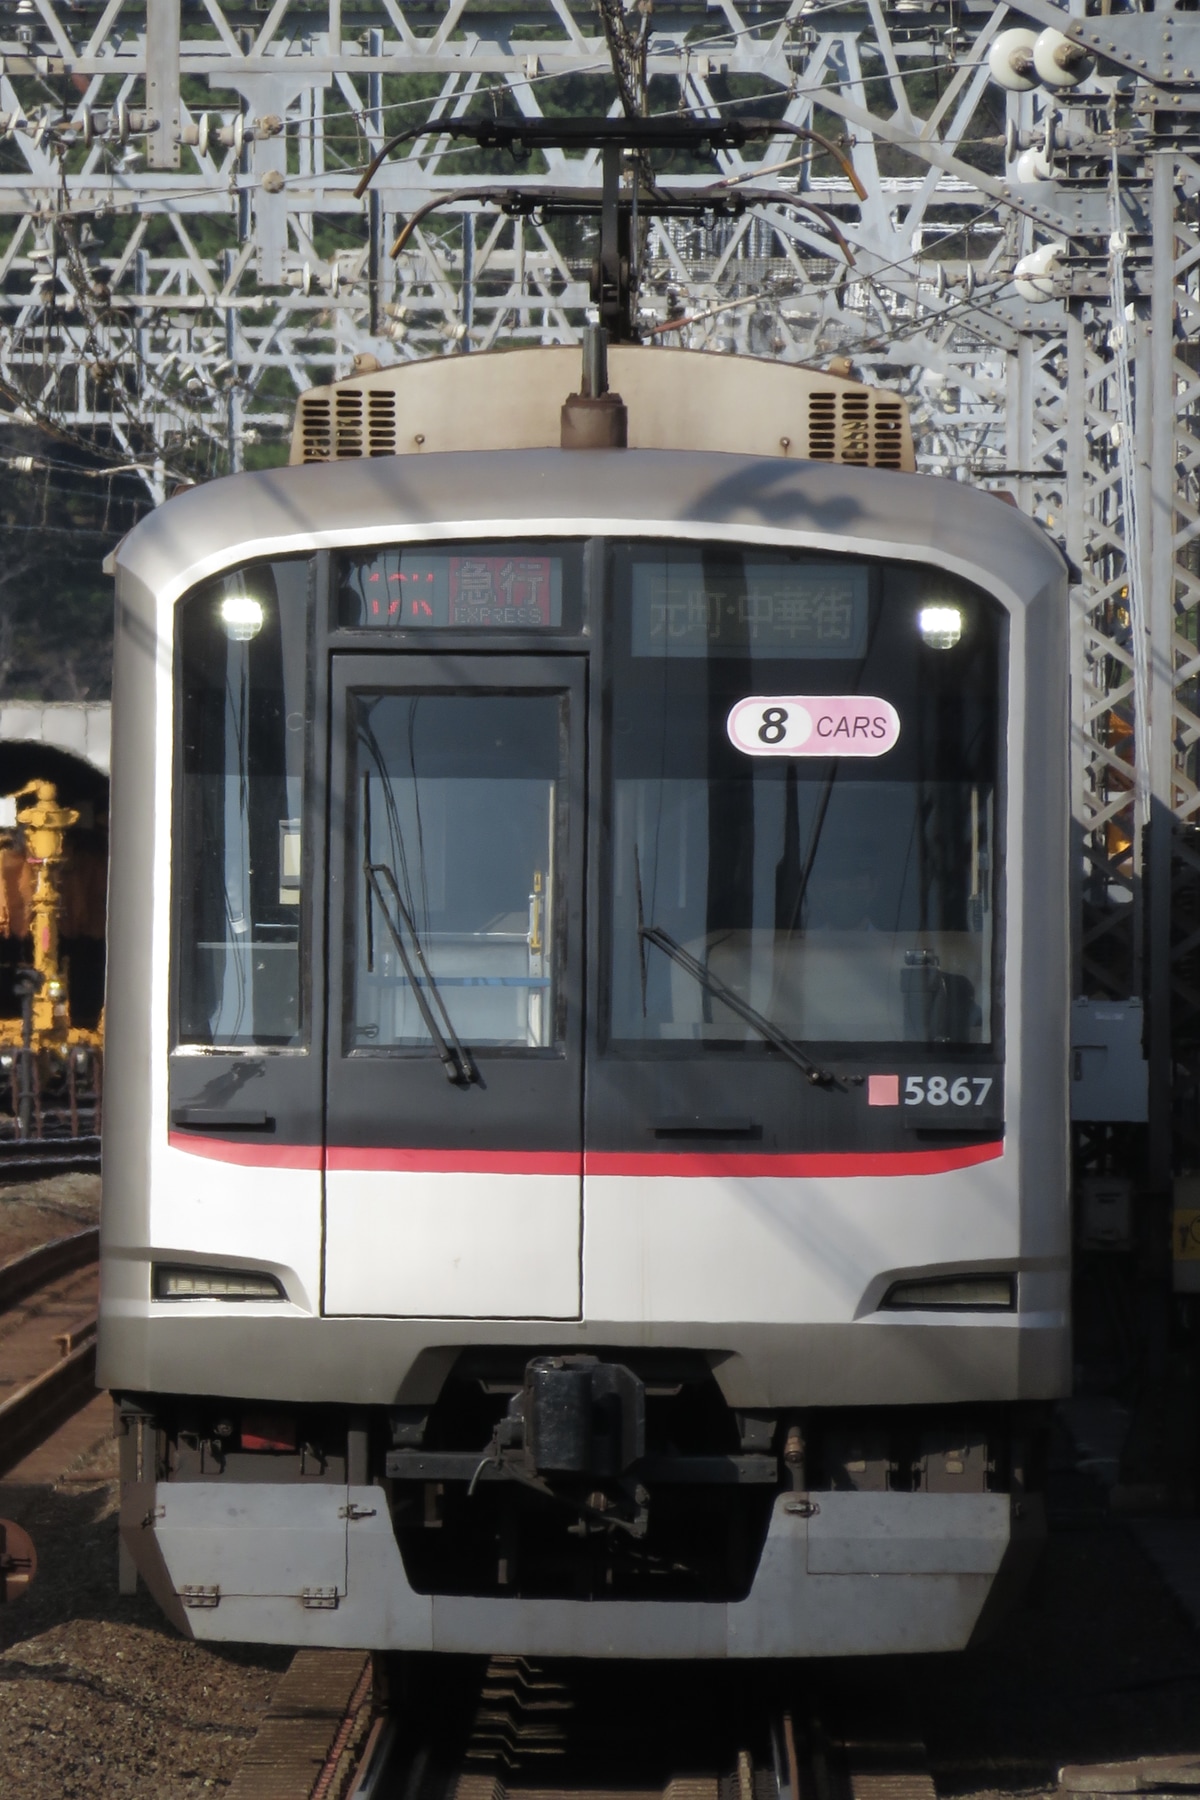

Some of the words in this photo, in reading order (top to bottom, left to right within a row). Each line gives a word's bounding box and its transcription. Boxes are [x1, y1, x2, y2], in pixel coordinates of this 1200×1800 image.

[455, 561, 543, 604] 急行
[454, 608, 542, 624] EXPRESS
[758, 707, 788, 744] 8
[816, 716, 887, 738] CARS
[904, 1076, 993, 1106] 5867
